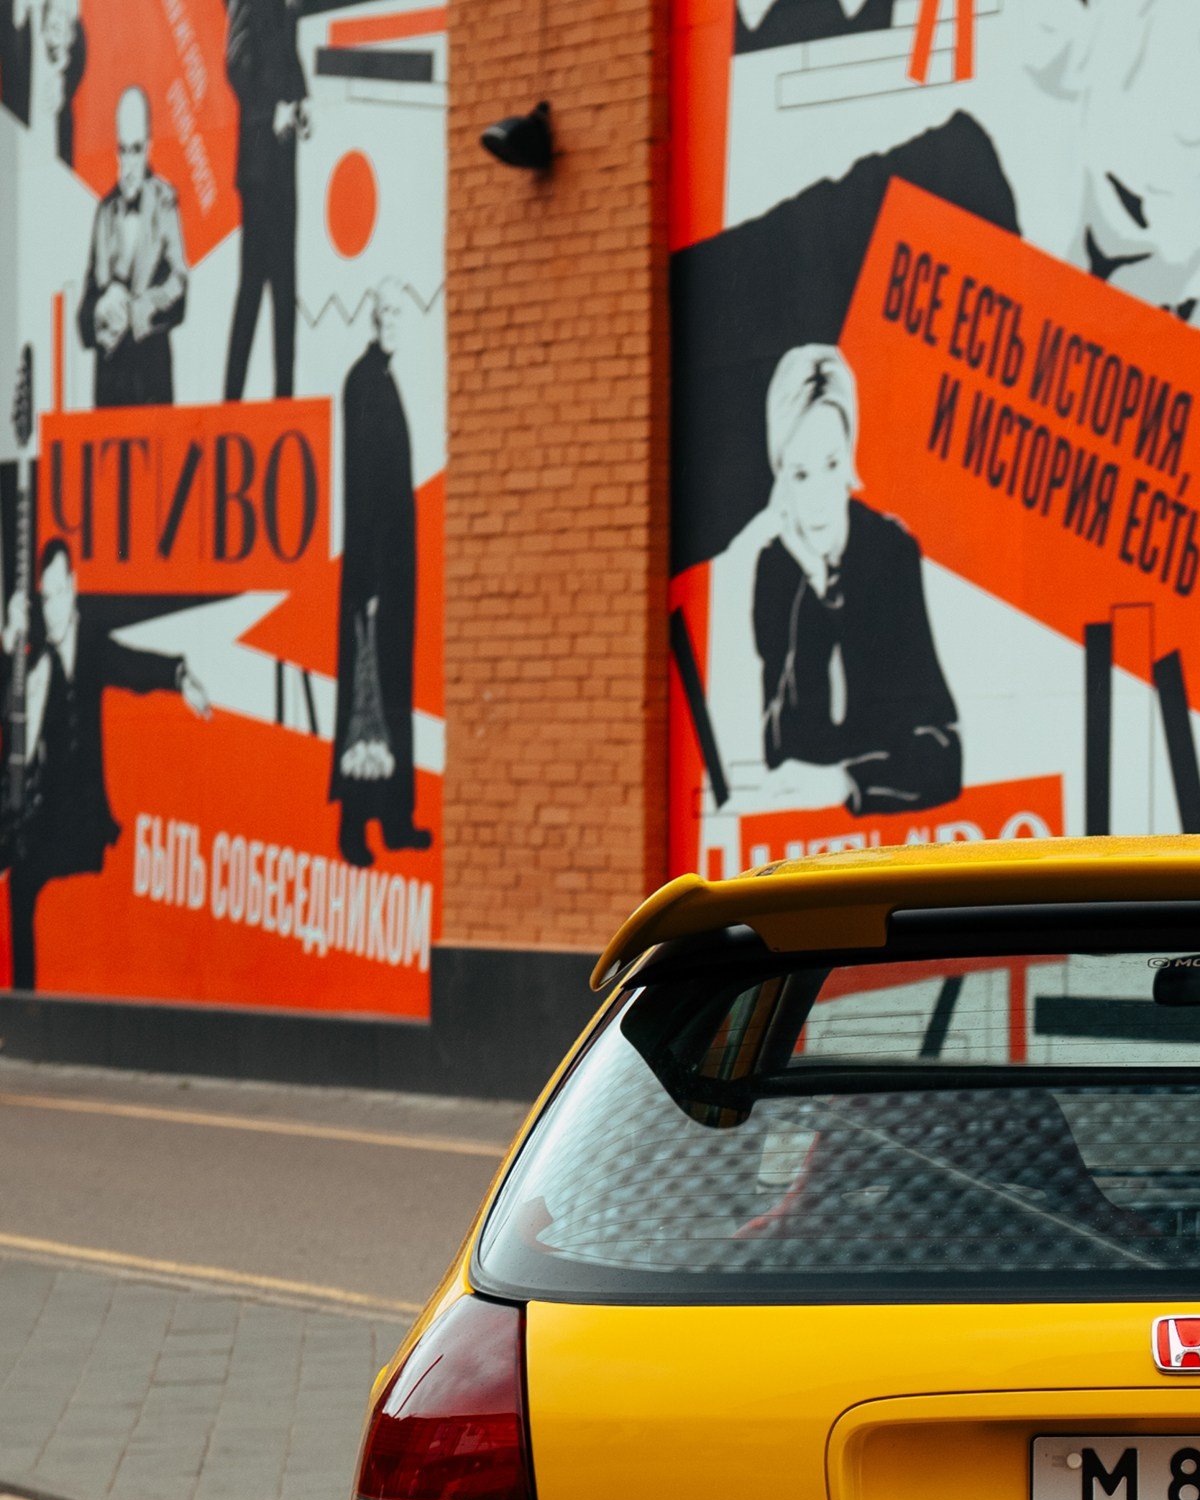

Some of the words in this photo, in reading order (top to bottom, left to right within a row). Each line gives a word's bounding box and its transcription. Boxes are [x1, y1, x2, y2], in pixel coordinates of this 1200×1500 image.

[883, 241, 949, 346] ВСЕ
[949, 275, 1025, 388] ЕСТЬ
[1029, 318, 1193, 498] ИСТОРИЯ,
[50, 429, 318, 564] ЧТИВО
[928, 371, 961, 461] И
[963, 390, 1120, 548] ИСТОРИЯ
[1118, 478, 1199, 597] ЕСТЬ
[134, 813, 205, 910] БЫТЬ
[211, 832, 432, 973] СОБЕСЕДНИКОМ
